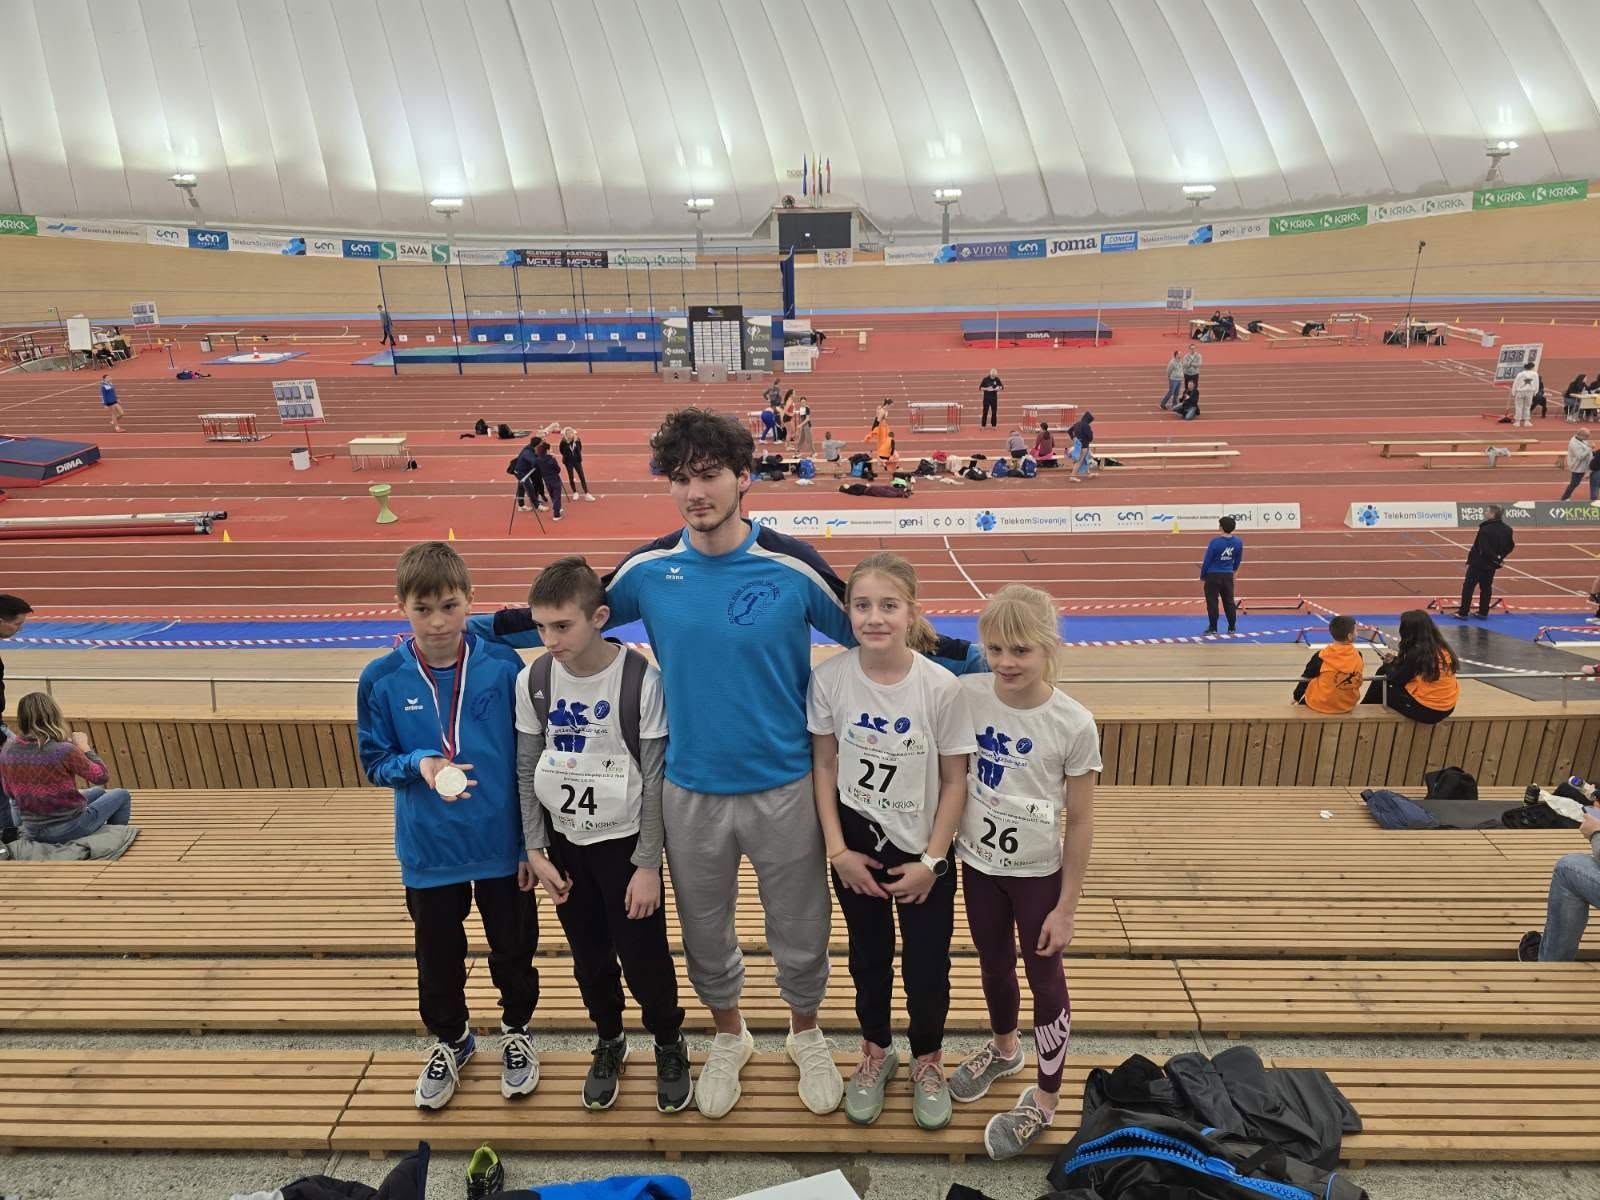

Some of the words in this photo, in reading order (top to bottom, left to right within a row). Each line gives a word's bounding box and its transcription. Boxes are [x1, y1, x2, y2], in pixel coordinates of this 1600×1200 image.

[1497, 191, 1526, 203] KRKA
[1550, 186, 1579, 197] KRKA
[1437, 199, 1465, 209] KRKA
[1389, 205, 1416, 216] KRKA
[1290, 218, 1315, 229] KRKA
[1334, 212, 1361, 224] KRKA
[400, 245, 428, 256] SAVA
[973, 245, 1008, 256] VIDIM
[56, 458, 84, 474] DIMA
[1505, 509, 1531, 518] KRKA
[1565, 507, 1600, 519] krka
[858, 758, 898, 793] 27
[560, 784, 598, 815] 24
[892, 800, 915, 809] KRKA
[980, 817, 1019, 854] 26
[1034, 1008, 1070, 1055] NIKE
